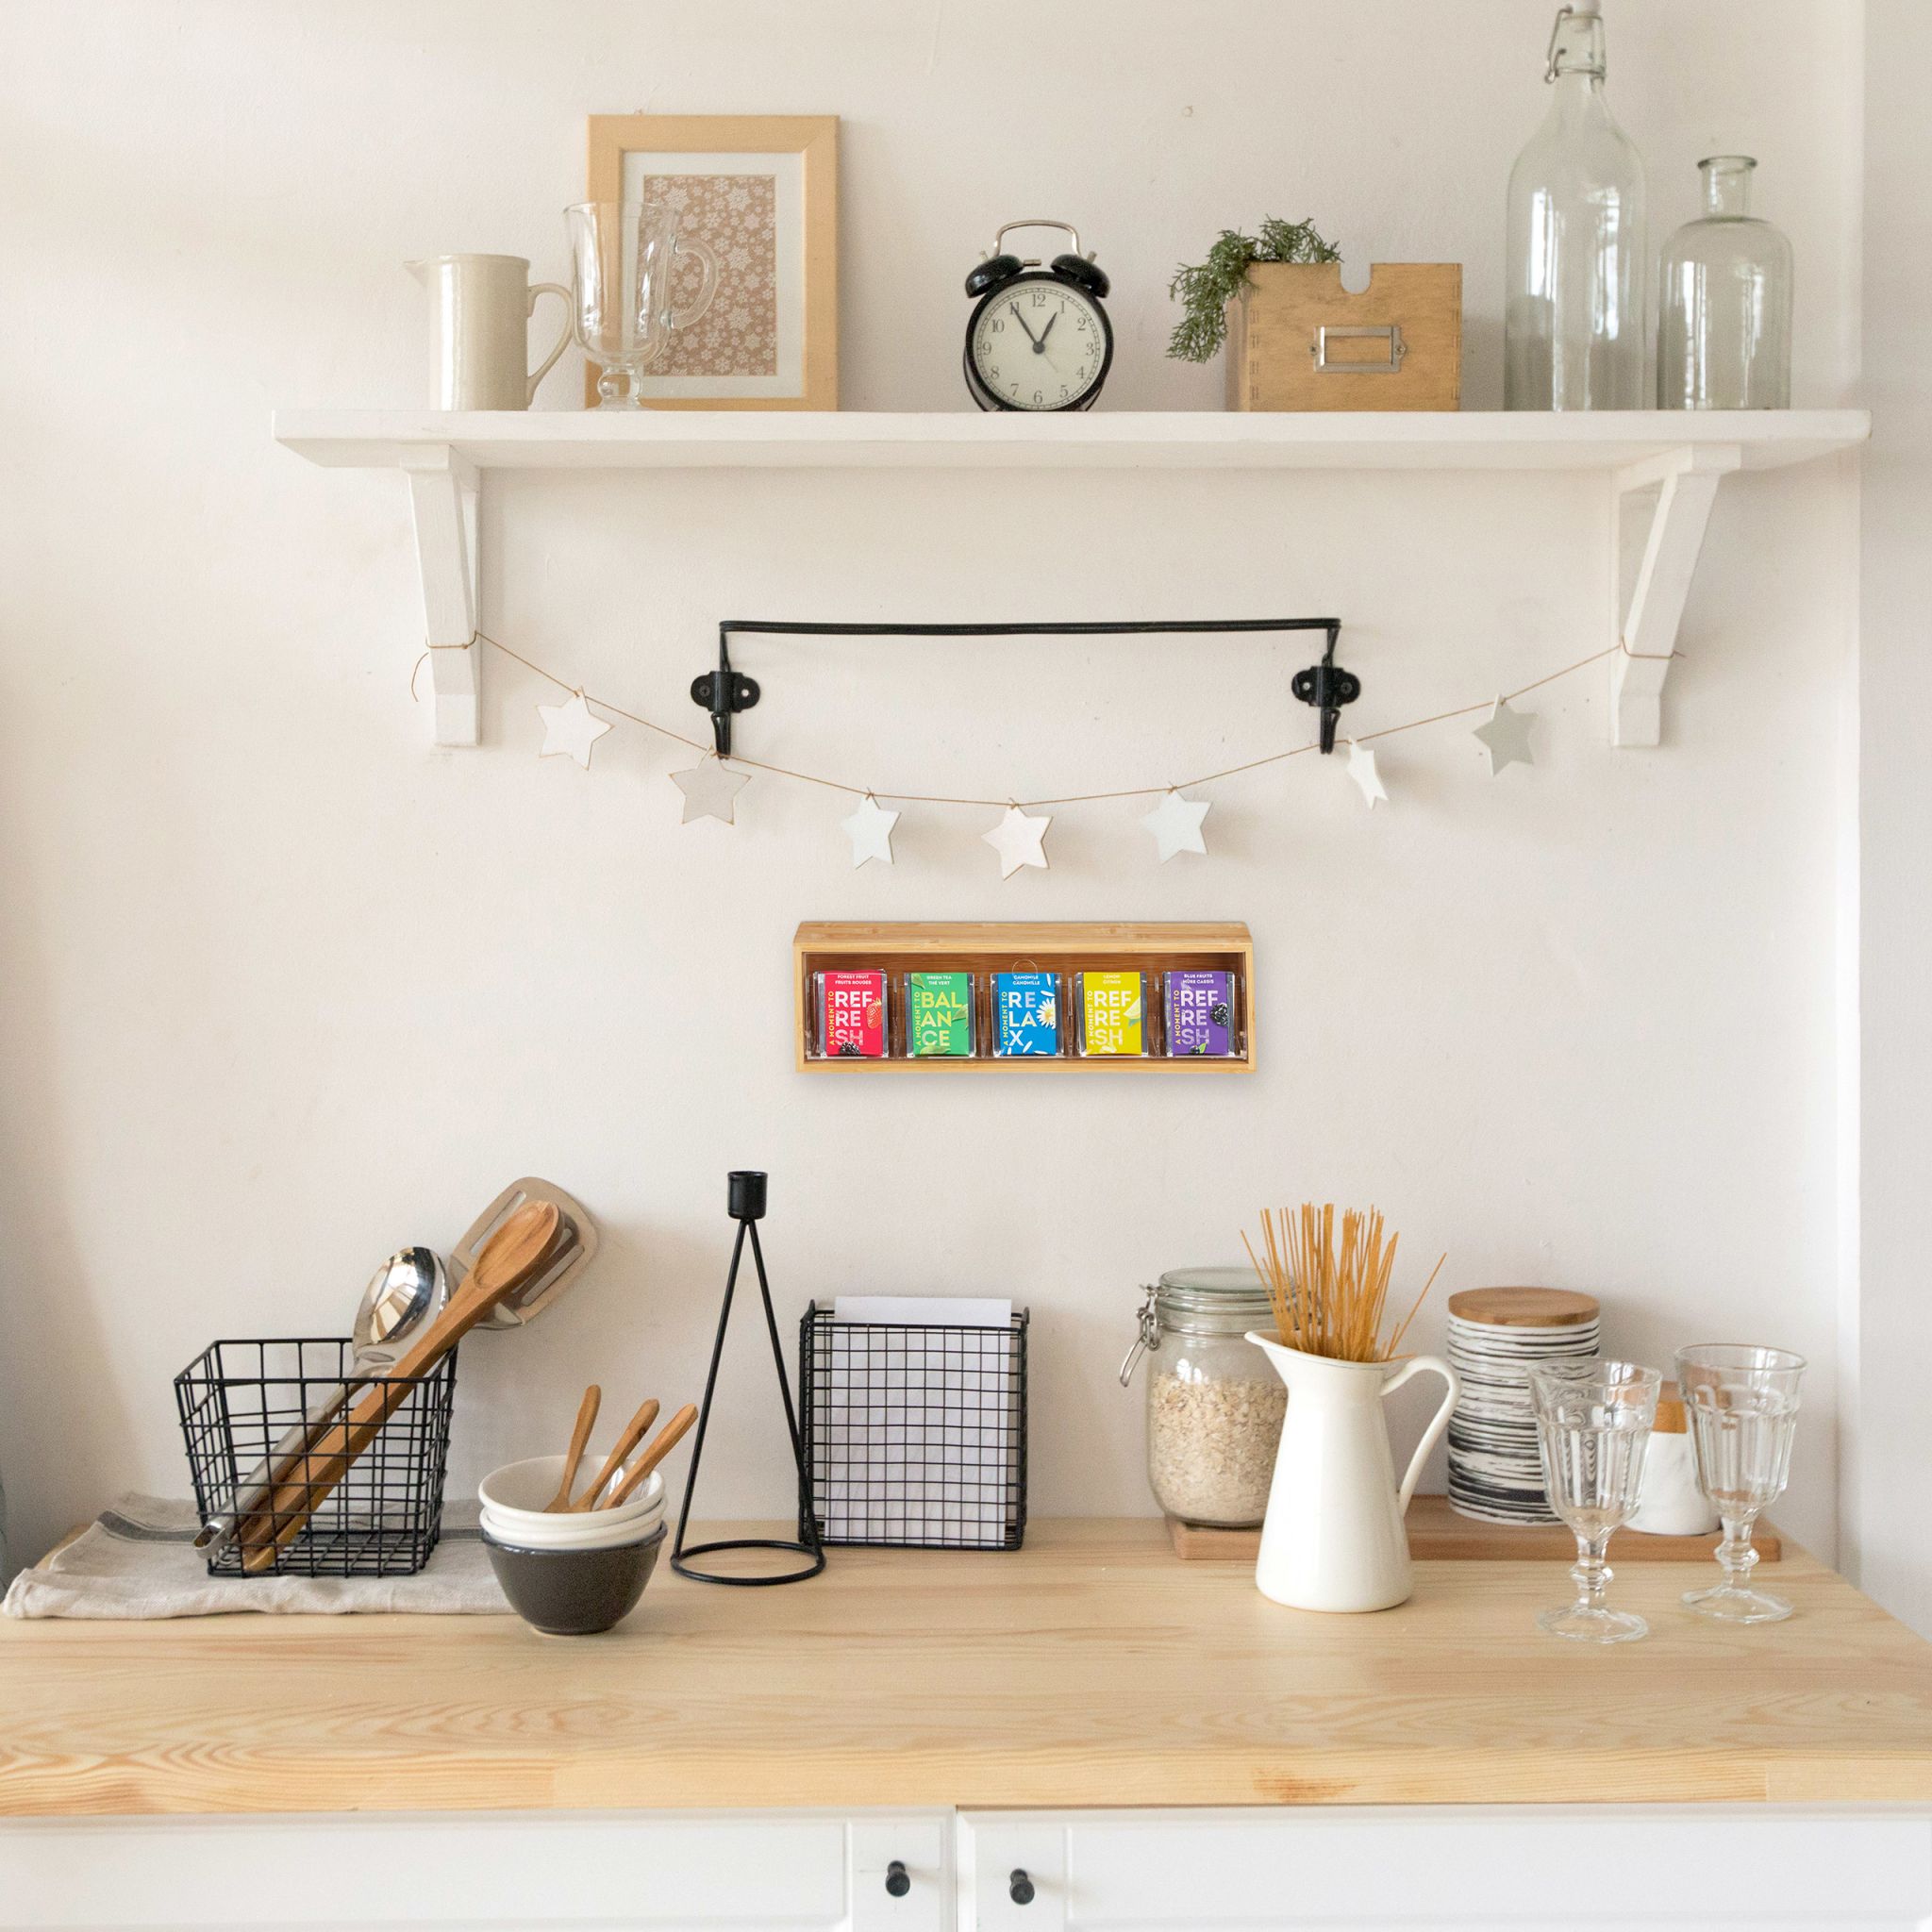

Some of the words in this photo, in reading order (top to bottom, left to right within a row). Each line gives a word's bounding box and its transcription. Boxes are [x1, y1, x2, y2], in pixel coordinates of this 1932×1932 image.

[1032, 294, 1046, 307] 12
[1060, 301, 1065, 313] 1
[991, 319, 1005, 332] 10
[1077, 318, 1086, 331] 2
[983, 342, 992, 355] 9
[1086, 343, 1094, 356] 3
[991, 367, 1000, 379] 8
[1076, 367, 1084, 378] 4
[1010, 383, 1019, 396] 7
[1059, 385, 1068, 397] 5
[1034, 391, 1043, 404] 6
[828, 991, 834, 1001] TO
[835, 991, 873, 1008] REF
[914, 991, 920, 1001] TO
[922, 991, 963, 1008] BAL
[1002, 991, 1008, 1002] TO
[1008, 991, 1036, 1008] RE
[1088, 991, 1092, 1001] TO
[1094, 991, 1131, 1007] REF
[1174, 991, 1179, 1000] TO
[1180, 991, 1218, 1007] REF
[836, 1010, 861, 1026] RE
[921, 1011, 952, 1027] AN
[1009, 1011, 1037, 1026] LA
[1094, 1010, 1120, 1026] RE
[1181, 1009, 1208, 1025] RE
[835, 1029, 863, 1046] SH
[922, 1030, 950, 1046] CE
[1009, 1030, 1024, 1046] X
[1094, 1028, 1123, 1045] SH
[1181, 1028, 1209, 1044] SH
